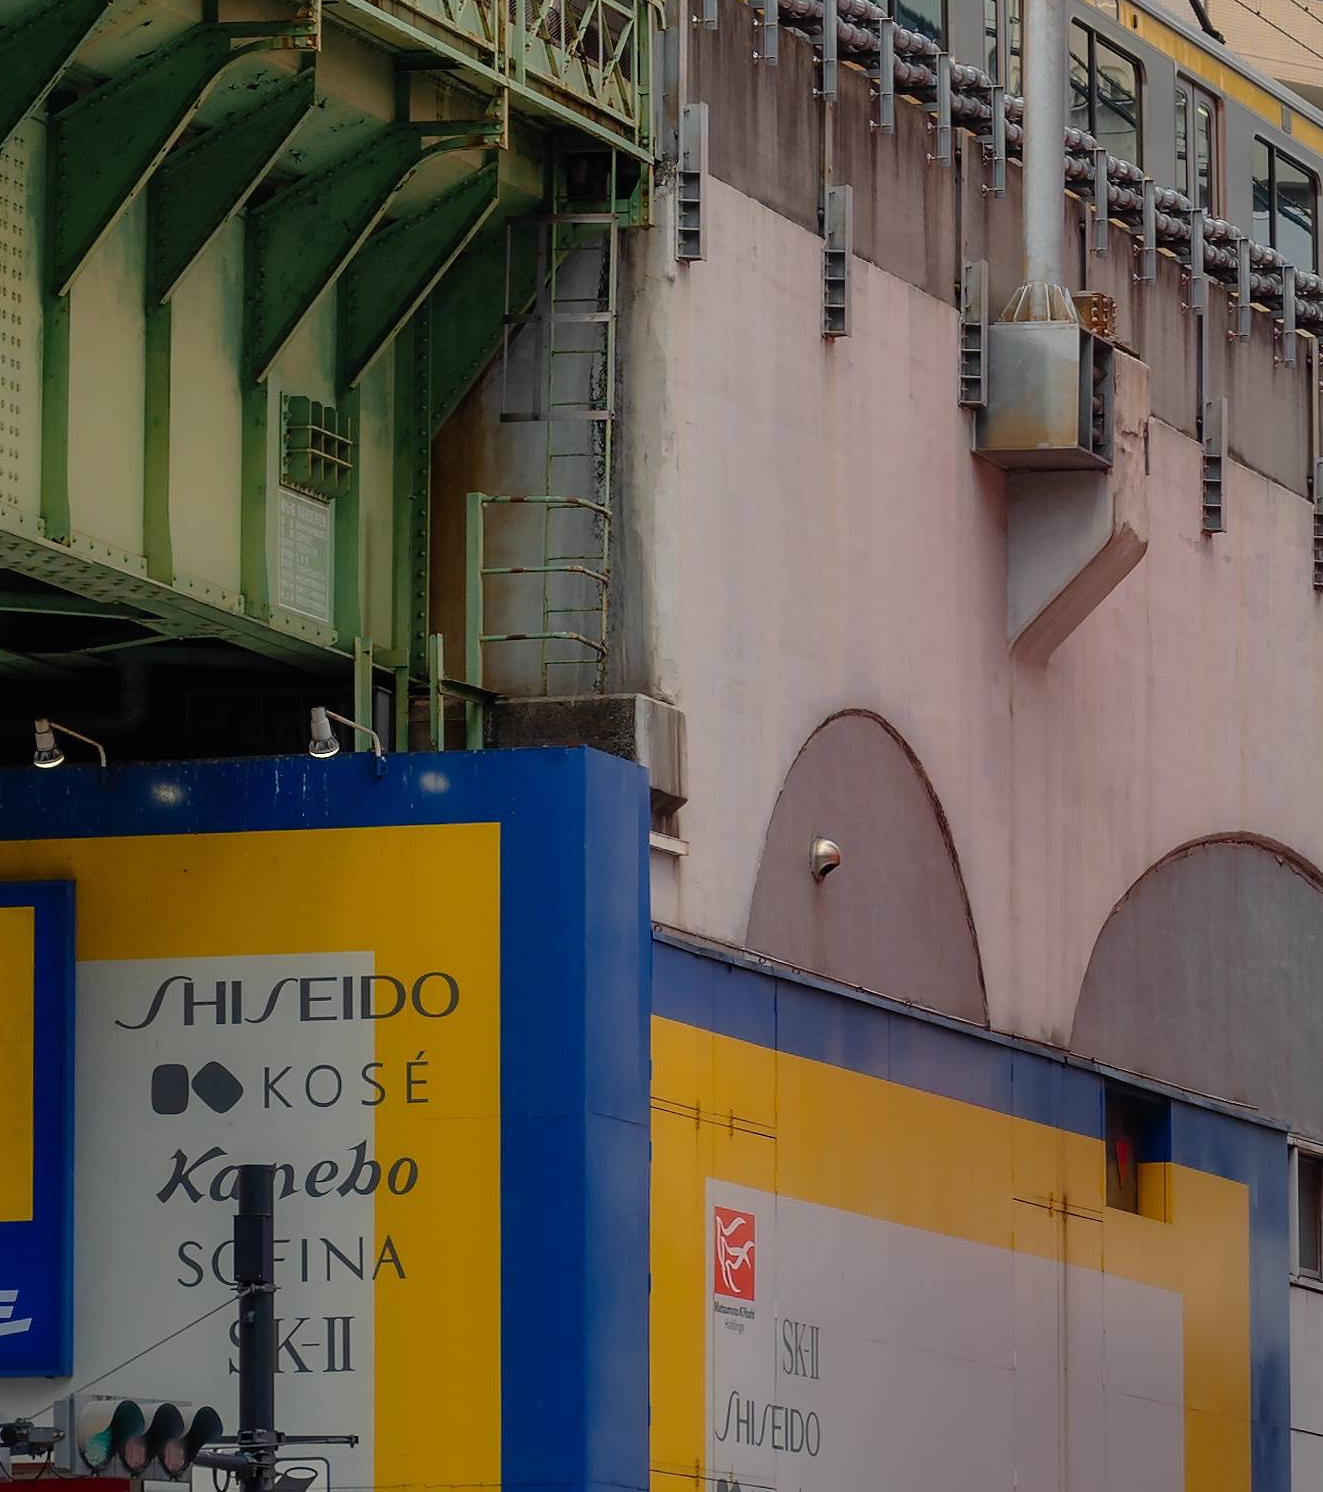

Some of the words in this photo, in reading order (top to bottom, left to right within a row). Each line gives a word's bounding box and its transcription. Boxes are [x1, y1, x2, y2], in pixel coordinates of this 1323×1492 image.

[115, 971, 460, 1031] SHISEIDO
[264, 1052, 430, 1109] KOSÉ
[783, 1319, 820, 1380] SK-II
[715, 1389, 820, 1457] SHISEIDO
